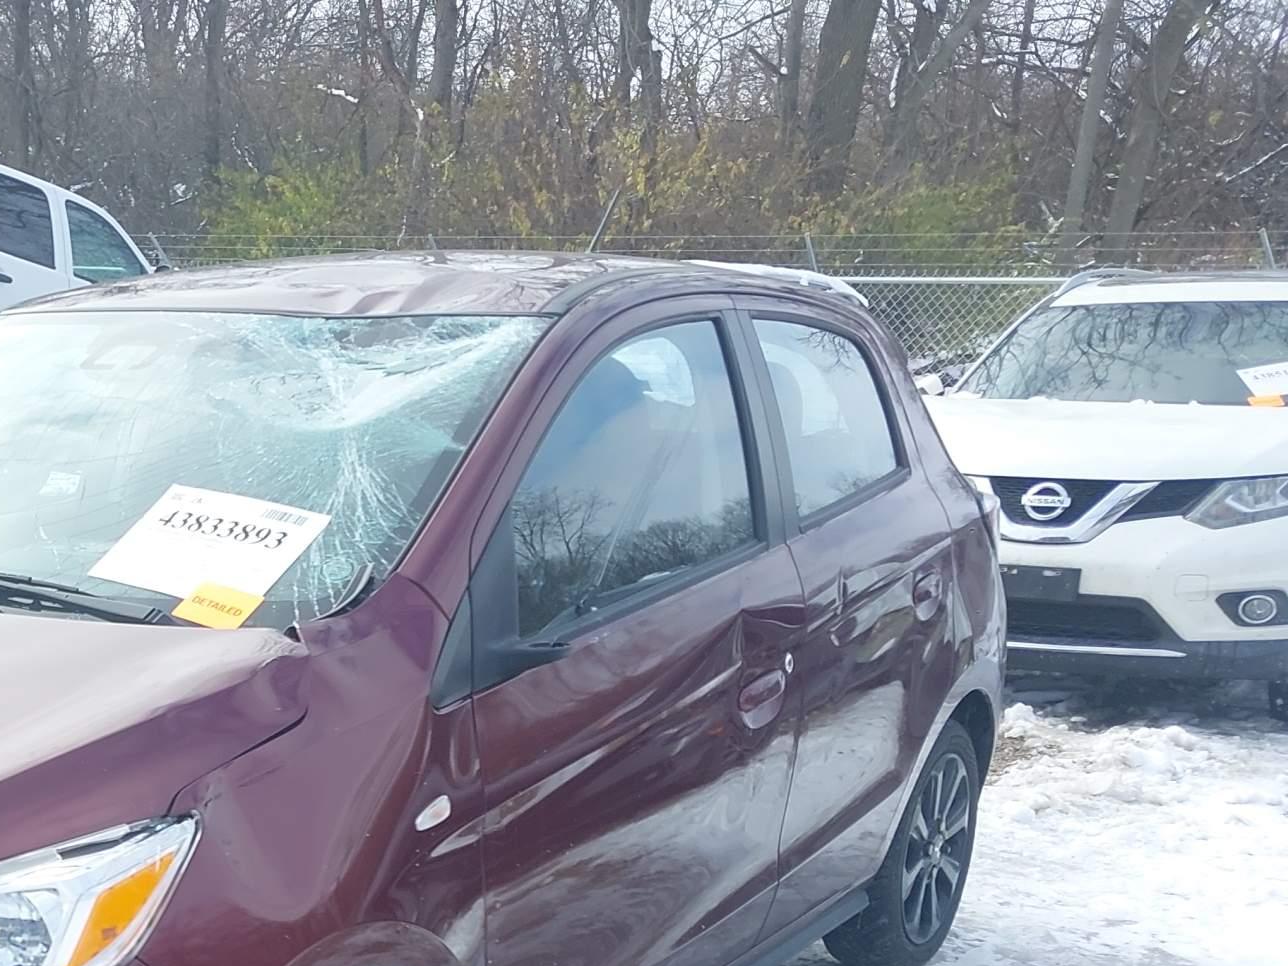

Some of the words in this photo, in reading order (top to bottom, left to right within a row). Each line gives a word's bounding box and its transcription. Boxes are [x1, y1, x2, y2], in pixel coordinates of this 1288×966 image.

[1027, 497, 1065, 505] NISSAN
[158, 509, 289, 550] 43833893
[191, 594, 243, 617] DETAILED
